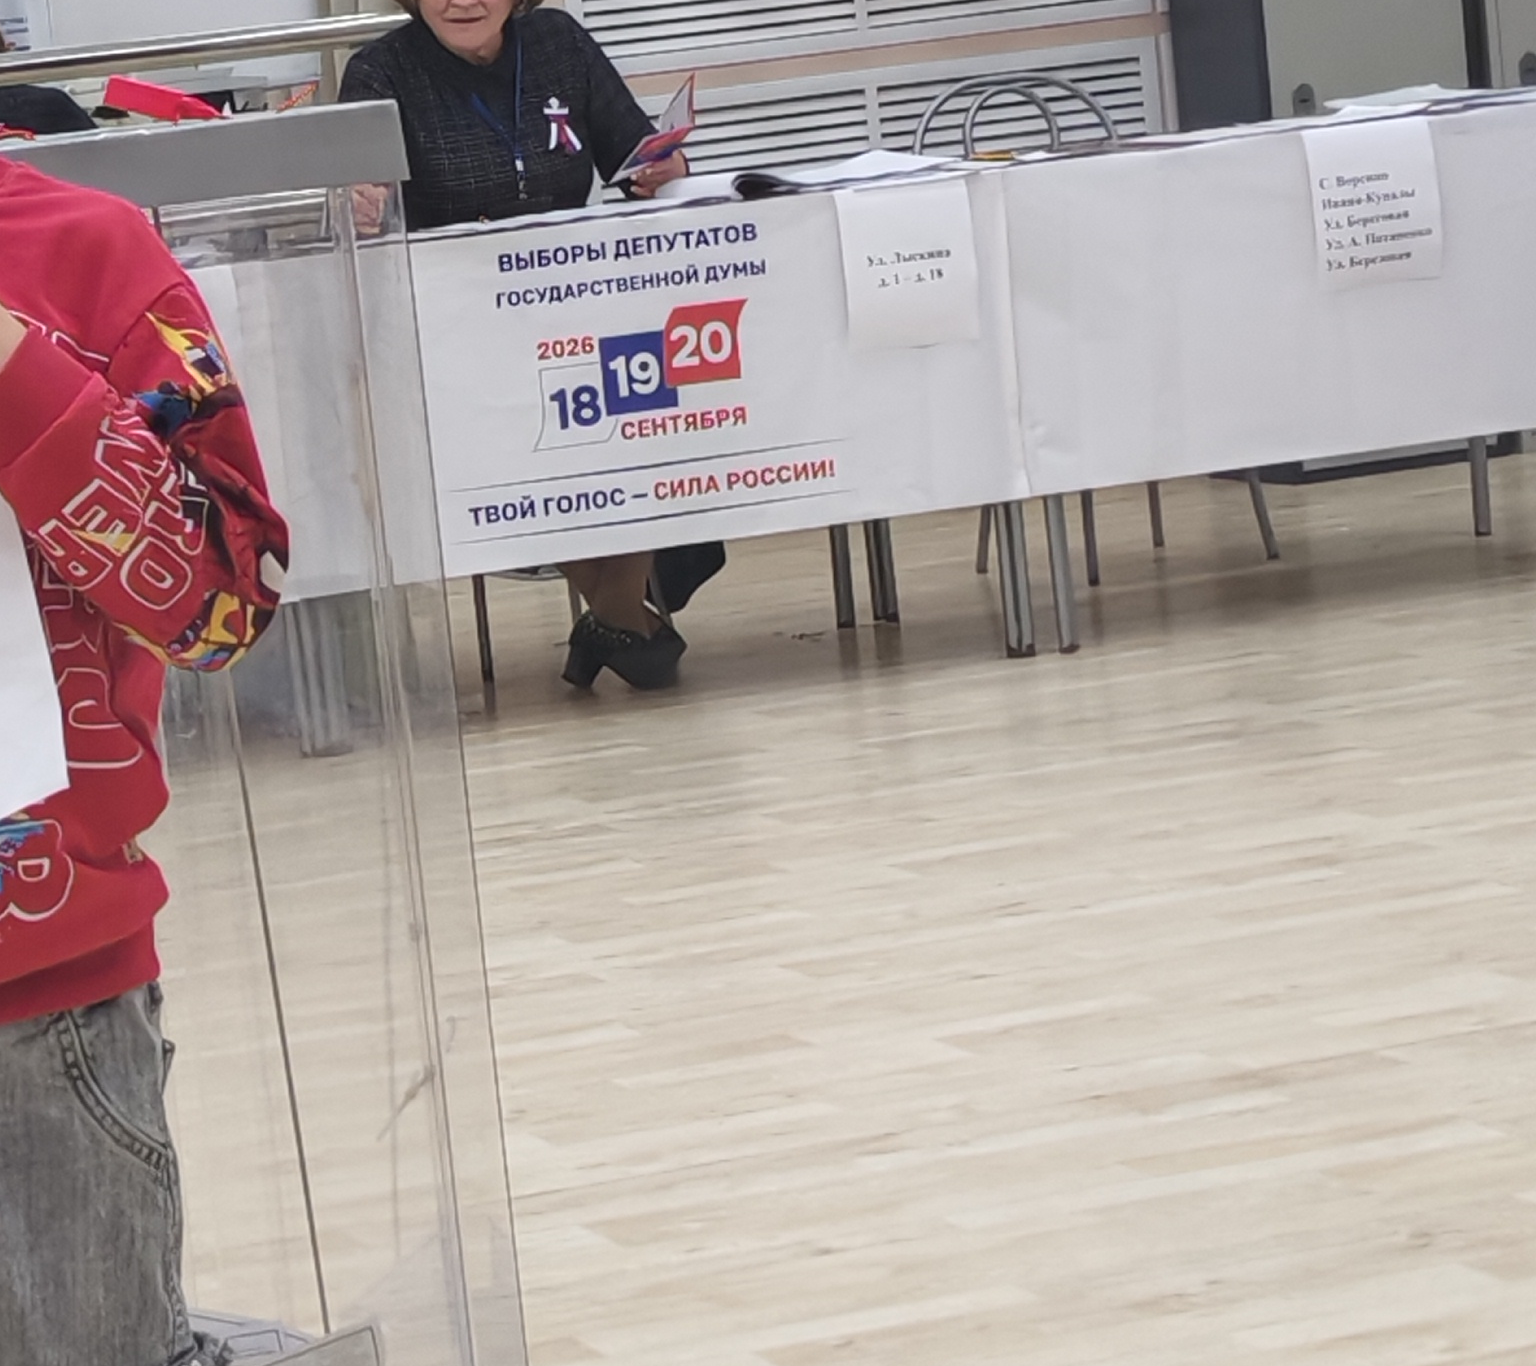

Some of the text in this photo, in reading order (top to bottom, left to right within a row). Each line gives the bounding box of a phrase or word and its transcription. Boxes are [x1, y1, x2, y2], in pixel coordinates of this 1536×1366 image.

[497, 222, 758, 274] ВЫБОРЫ ДЕПУТАТОВ
[495, 258, 767, 309] ГОСУДАРСТВЕННОЙ ДУМЫ
[537, 335, 596, 361] 2026
[549, 320, 733, 431] 18 19 20
[620, 405, 748, 441] СЕНТЯБРЯ
[467, 496, 537, 527] ТВОЙ
[543, 487, 626, 517] ГОЛОС
[653, 475, 721, 502] СИЛА
[726, 459, 837, 492] РОССИИ!
